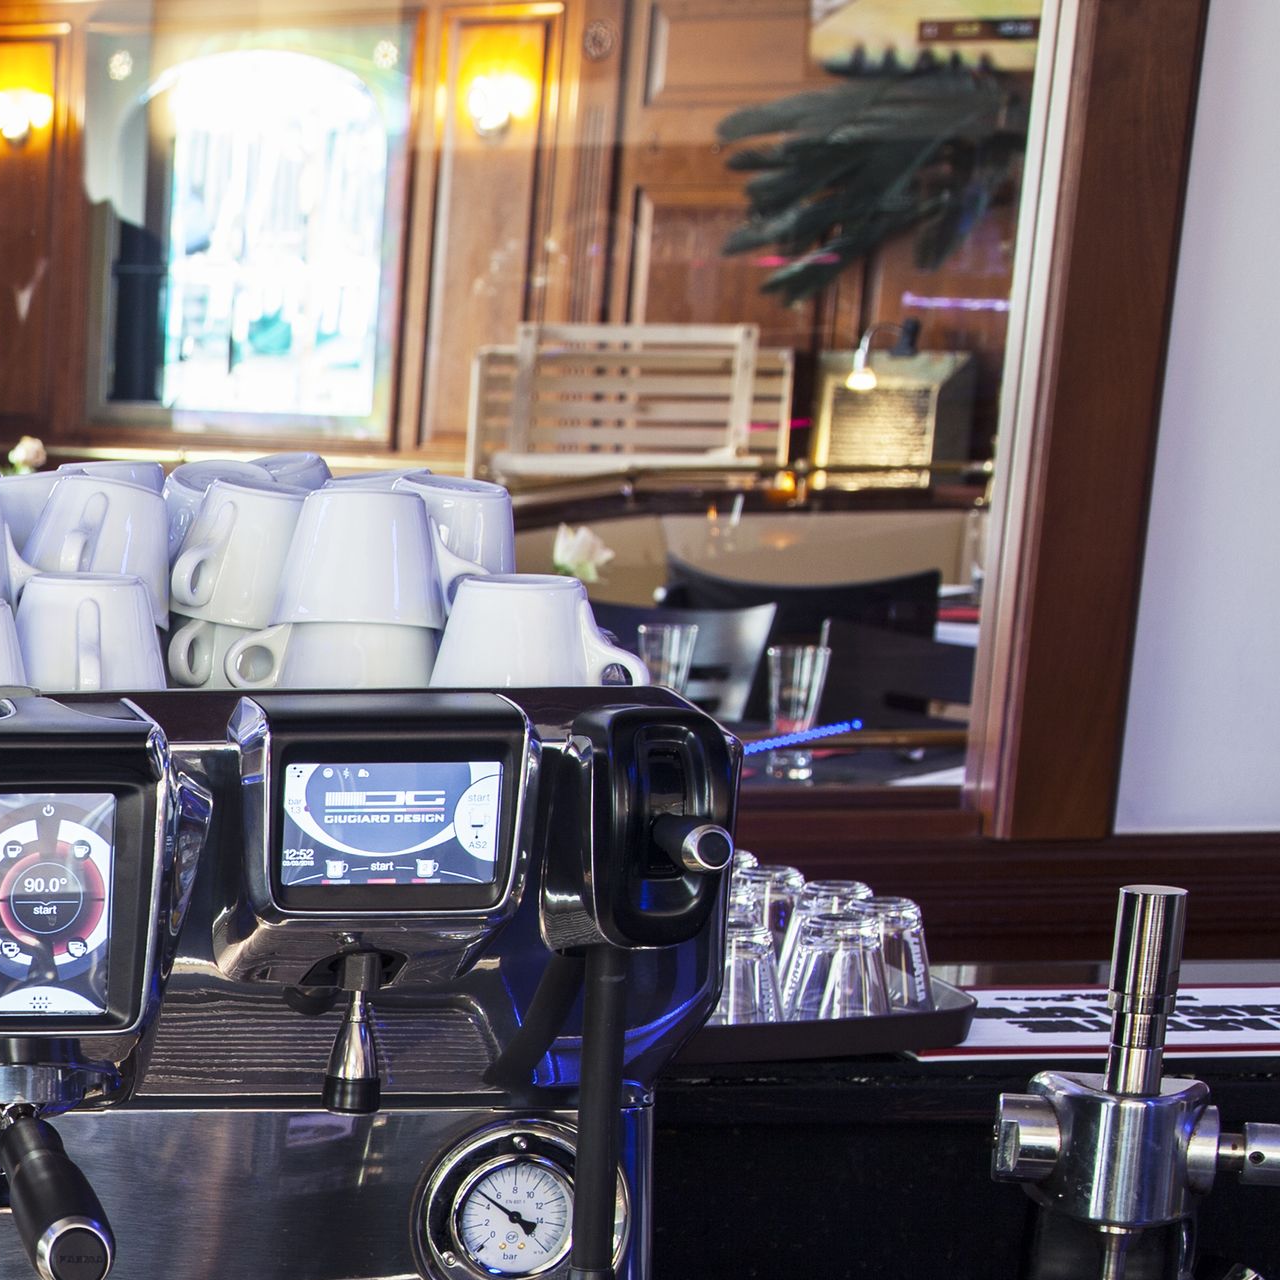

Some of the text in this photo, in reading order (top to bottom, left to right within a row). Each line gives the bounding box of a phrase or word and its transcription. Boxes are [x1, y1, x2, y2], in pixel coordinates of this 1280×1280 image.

[468, 794, 491, 802] start
[324, 814, 445, 824] GIUGIARO DESIGN
[468, 841, 488, 849] AS2
[283, 849, 315, 860] 12:52
[370, 861, 394, 871] start
[24, 877, 68, 893] 90.0°
[33, 905, 57, 916] start
[512, 1186, 518, 1194] 8
[526, 1191, 535, 1199] 10
[536, 1202, 544, 1210] 12
